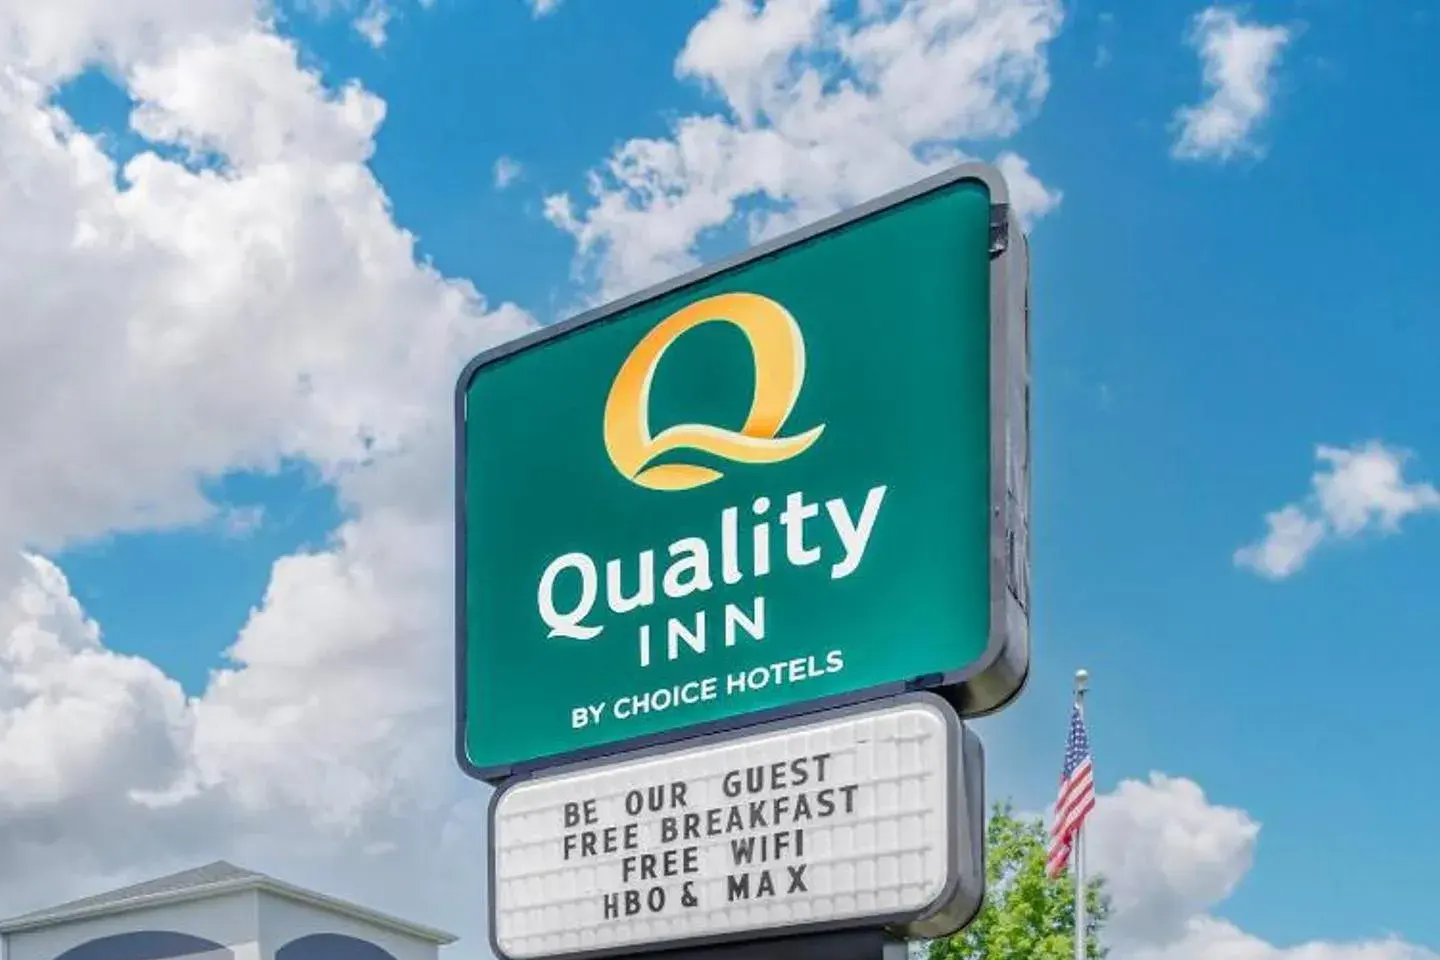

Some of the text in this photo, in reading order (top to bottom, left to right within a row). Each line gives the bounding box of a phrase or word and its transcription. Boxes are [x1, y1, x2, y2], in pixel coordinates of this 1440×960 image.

[603, 292, 826, 490] Q
[537, 486, 887, 640] Quality
[640, 597, 766, 667] INN
[571, 650, 844, 729] BY CHOICE HOTELS
[563, 753, 831, 828] BE OUR GUEST
[563, 784, 859, 860] FREE BREAKFAST
[603, 865, 808, 919] HBO & MAX
[622, 829, 805, 882] FREE WIFI
